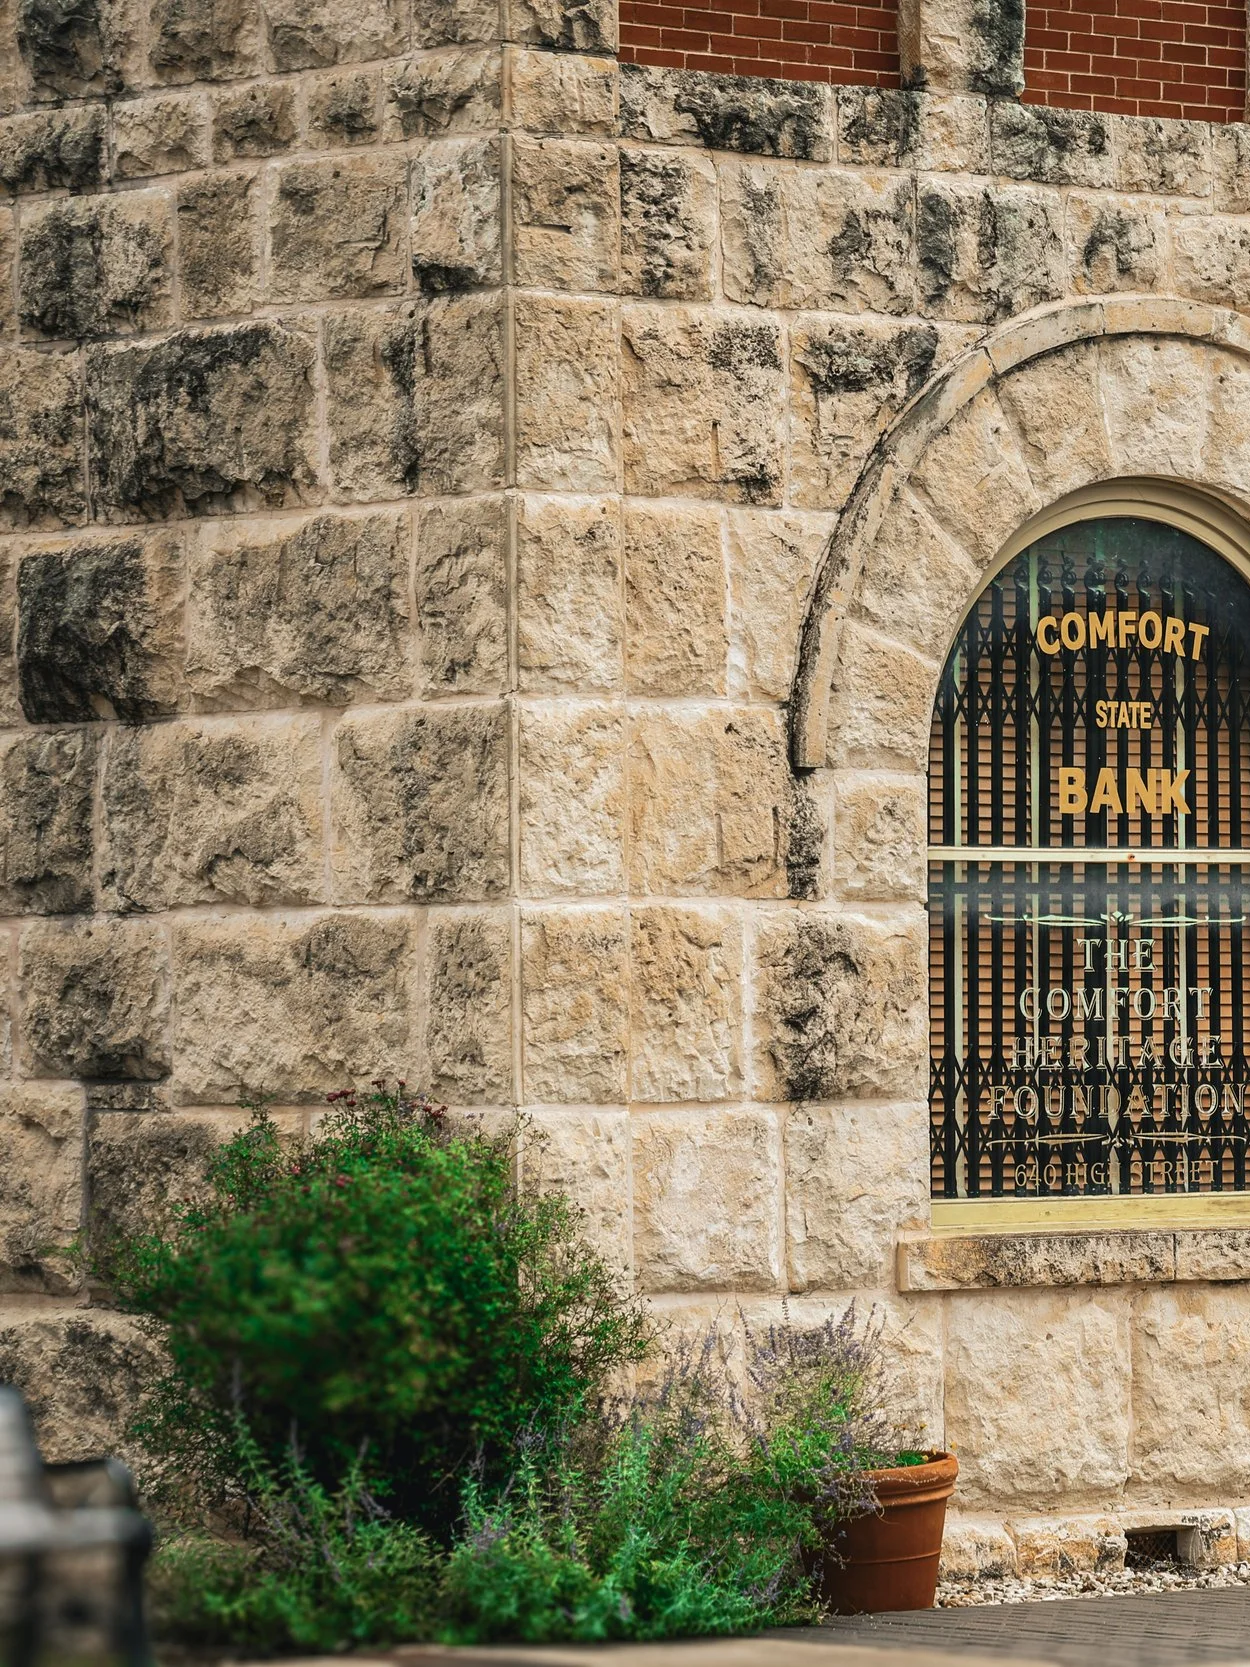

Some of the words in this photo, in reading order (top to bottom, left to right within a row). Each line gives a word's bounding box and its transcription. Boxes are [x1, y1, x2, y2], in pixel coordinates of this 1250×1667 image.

[1037, 610, 1210, 661] COMFORT
[1095, 700, 1152, 730] STATE
[1058, 767, 1191, 815] BANK
[1076, 938, 1158, 973] THE
[1019, 987, 1213, 1021] COMFORT
[1010, 1034, 1226, 1071] HERITAGE
[987, 1082, 1247, 1120] FOUNDATION
[1014, 1163, 1057, 1188] 640
[1066, 1161, 1121, 1186] HIGH
[1131, 1159, 1219, 1185] STREET
